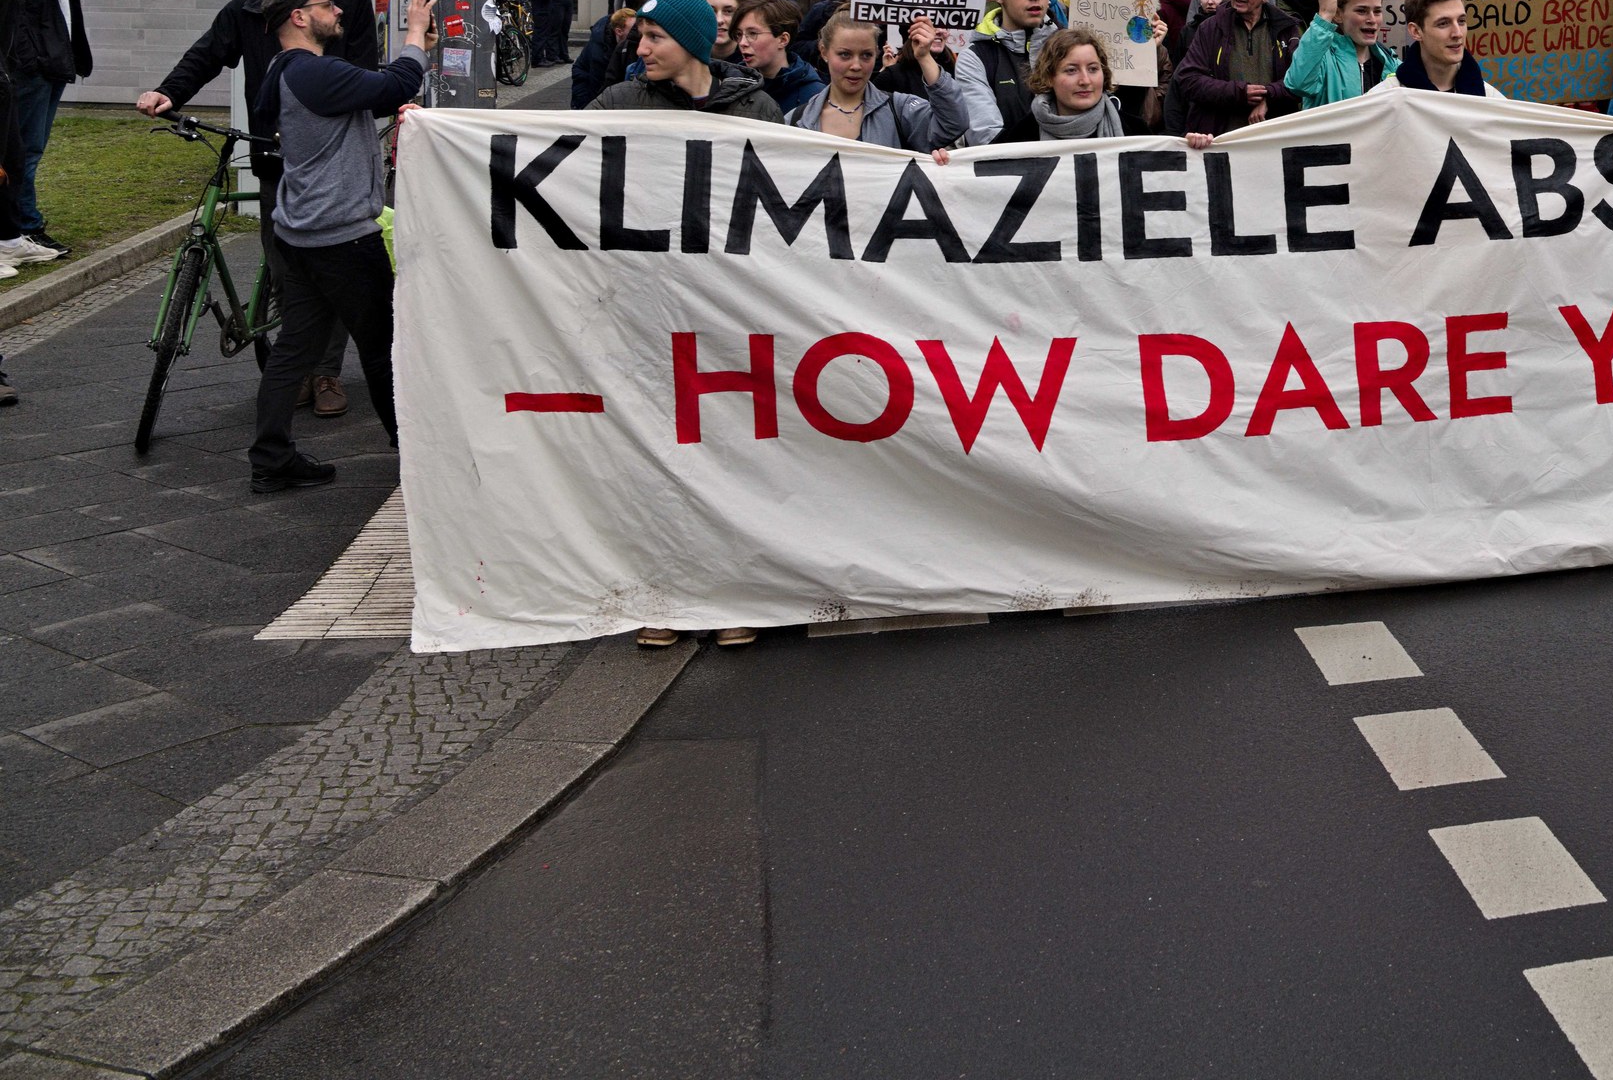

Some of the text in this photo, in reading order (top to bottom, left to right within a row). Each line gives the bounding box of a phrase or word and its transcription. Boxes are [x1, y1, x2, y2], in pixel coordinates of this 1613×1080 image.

[857, 4, 978, 27] EMERGENCY!
[1478, 48, 1613, 82] STEIGENDE
[489, 135, 1356, 264] KLIMAZIELE
[671, 332, 1077, 455] HOW
[1139, 312, 1513, 442] DARE
